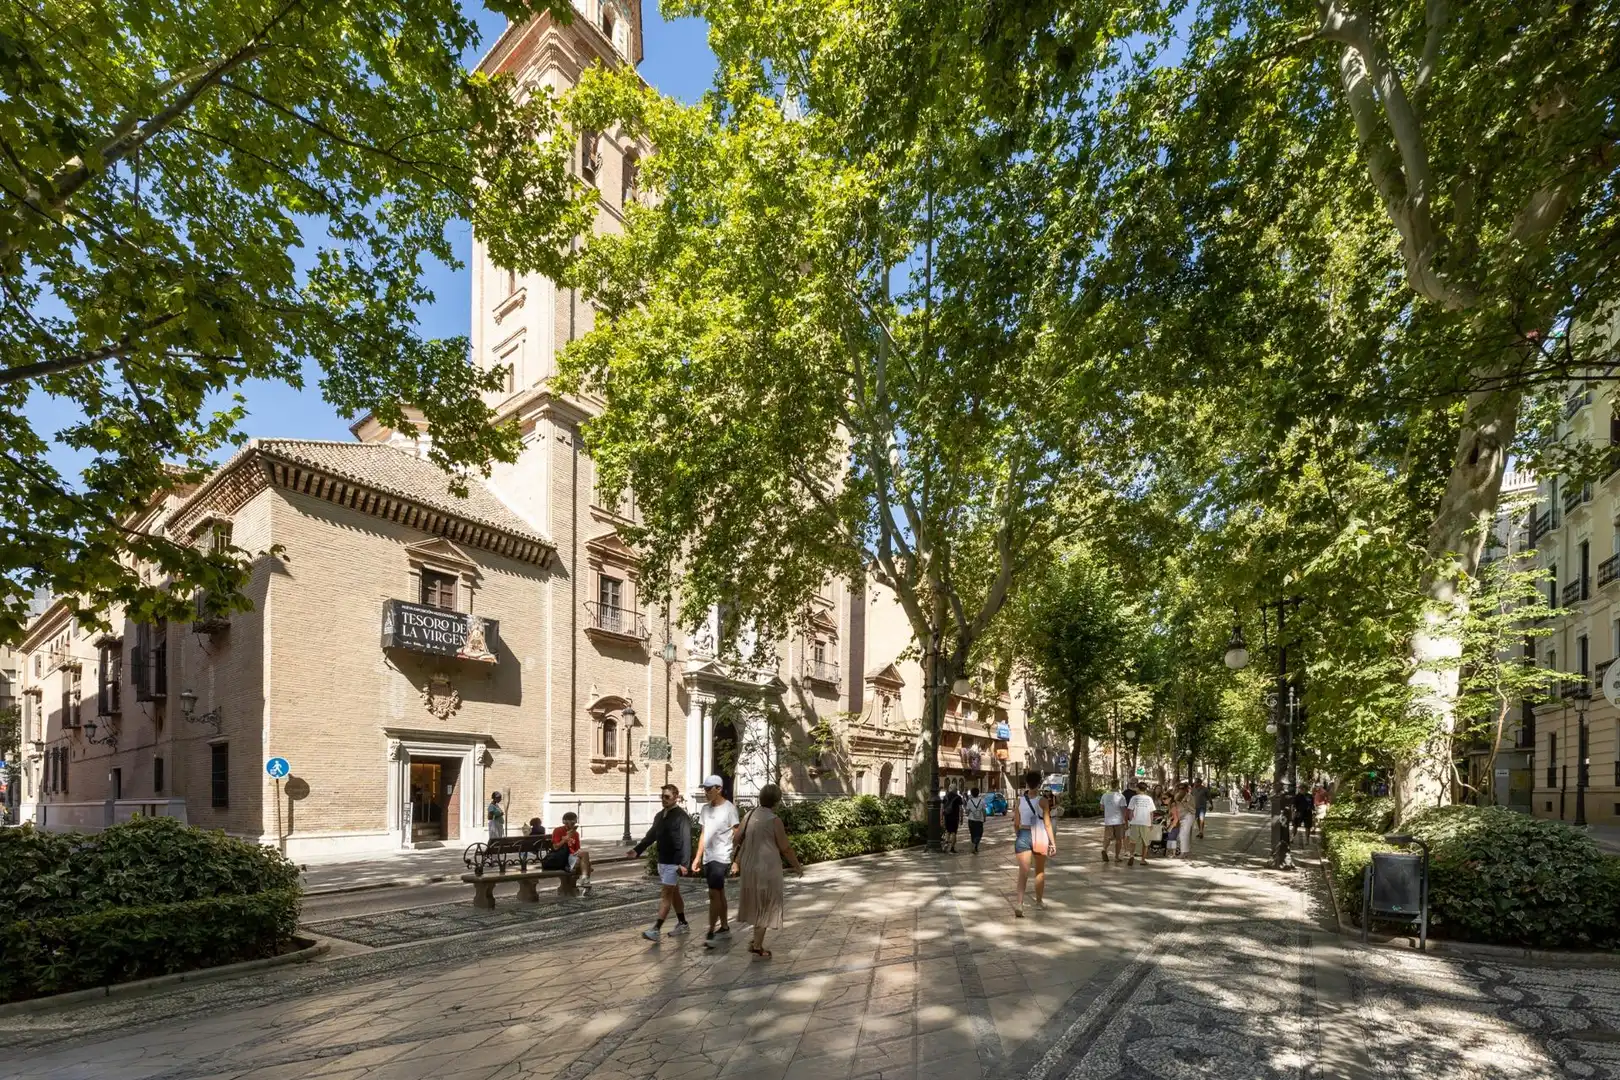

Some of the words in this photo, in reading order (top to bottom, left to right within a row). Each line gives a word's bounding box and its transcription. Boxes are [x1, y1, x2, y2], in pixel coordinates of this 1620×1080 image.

[401, 611, 449, 631] TESORO
[452, 621, 467, 634] DE
[402, 624, 418, 638] LA
[422, 628, 467, 645] VIRGEN
